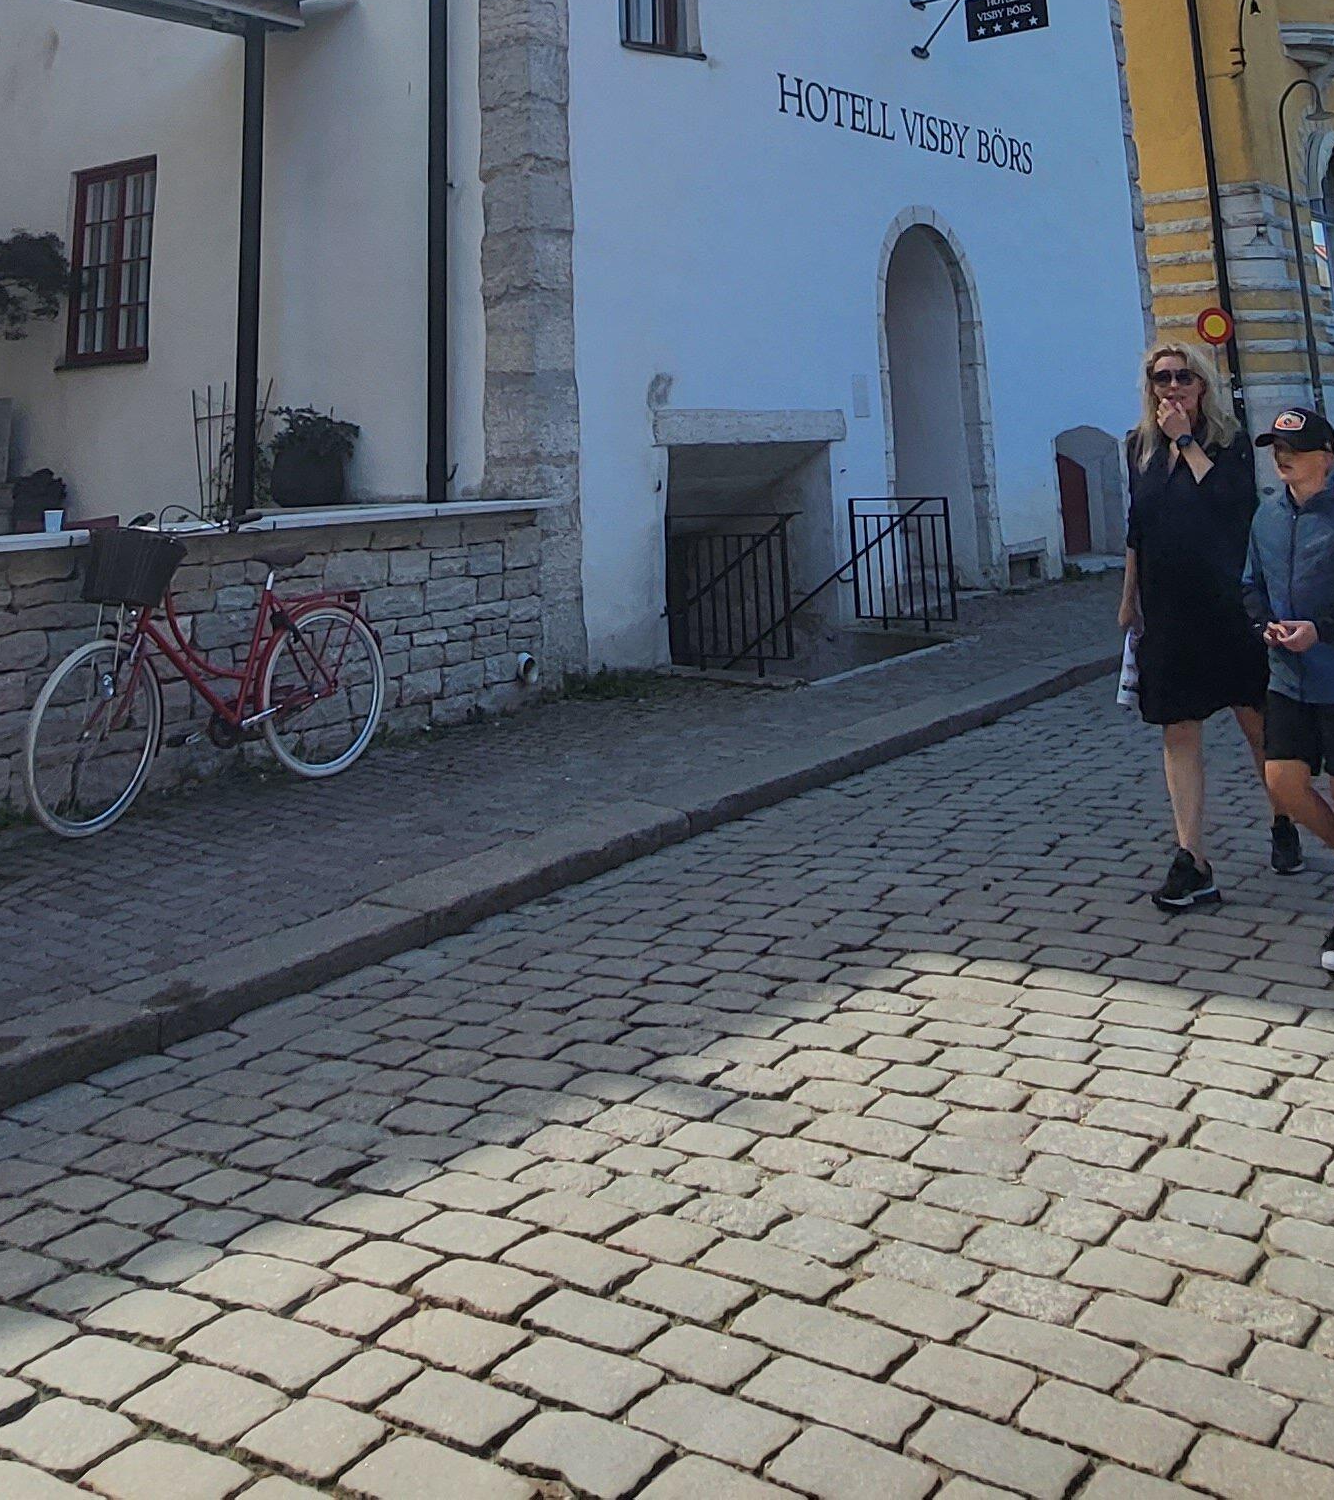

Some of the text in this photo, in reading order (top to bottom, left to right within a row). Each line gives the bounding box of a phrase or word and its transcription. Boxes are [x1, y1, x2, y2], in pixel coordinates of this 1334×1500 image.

[977, 8, 1004, 22] VISBY
[777, 73, 1034, 175] HOTELL VISBY BÖRS
